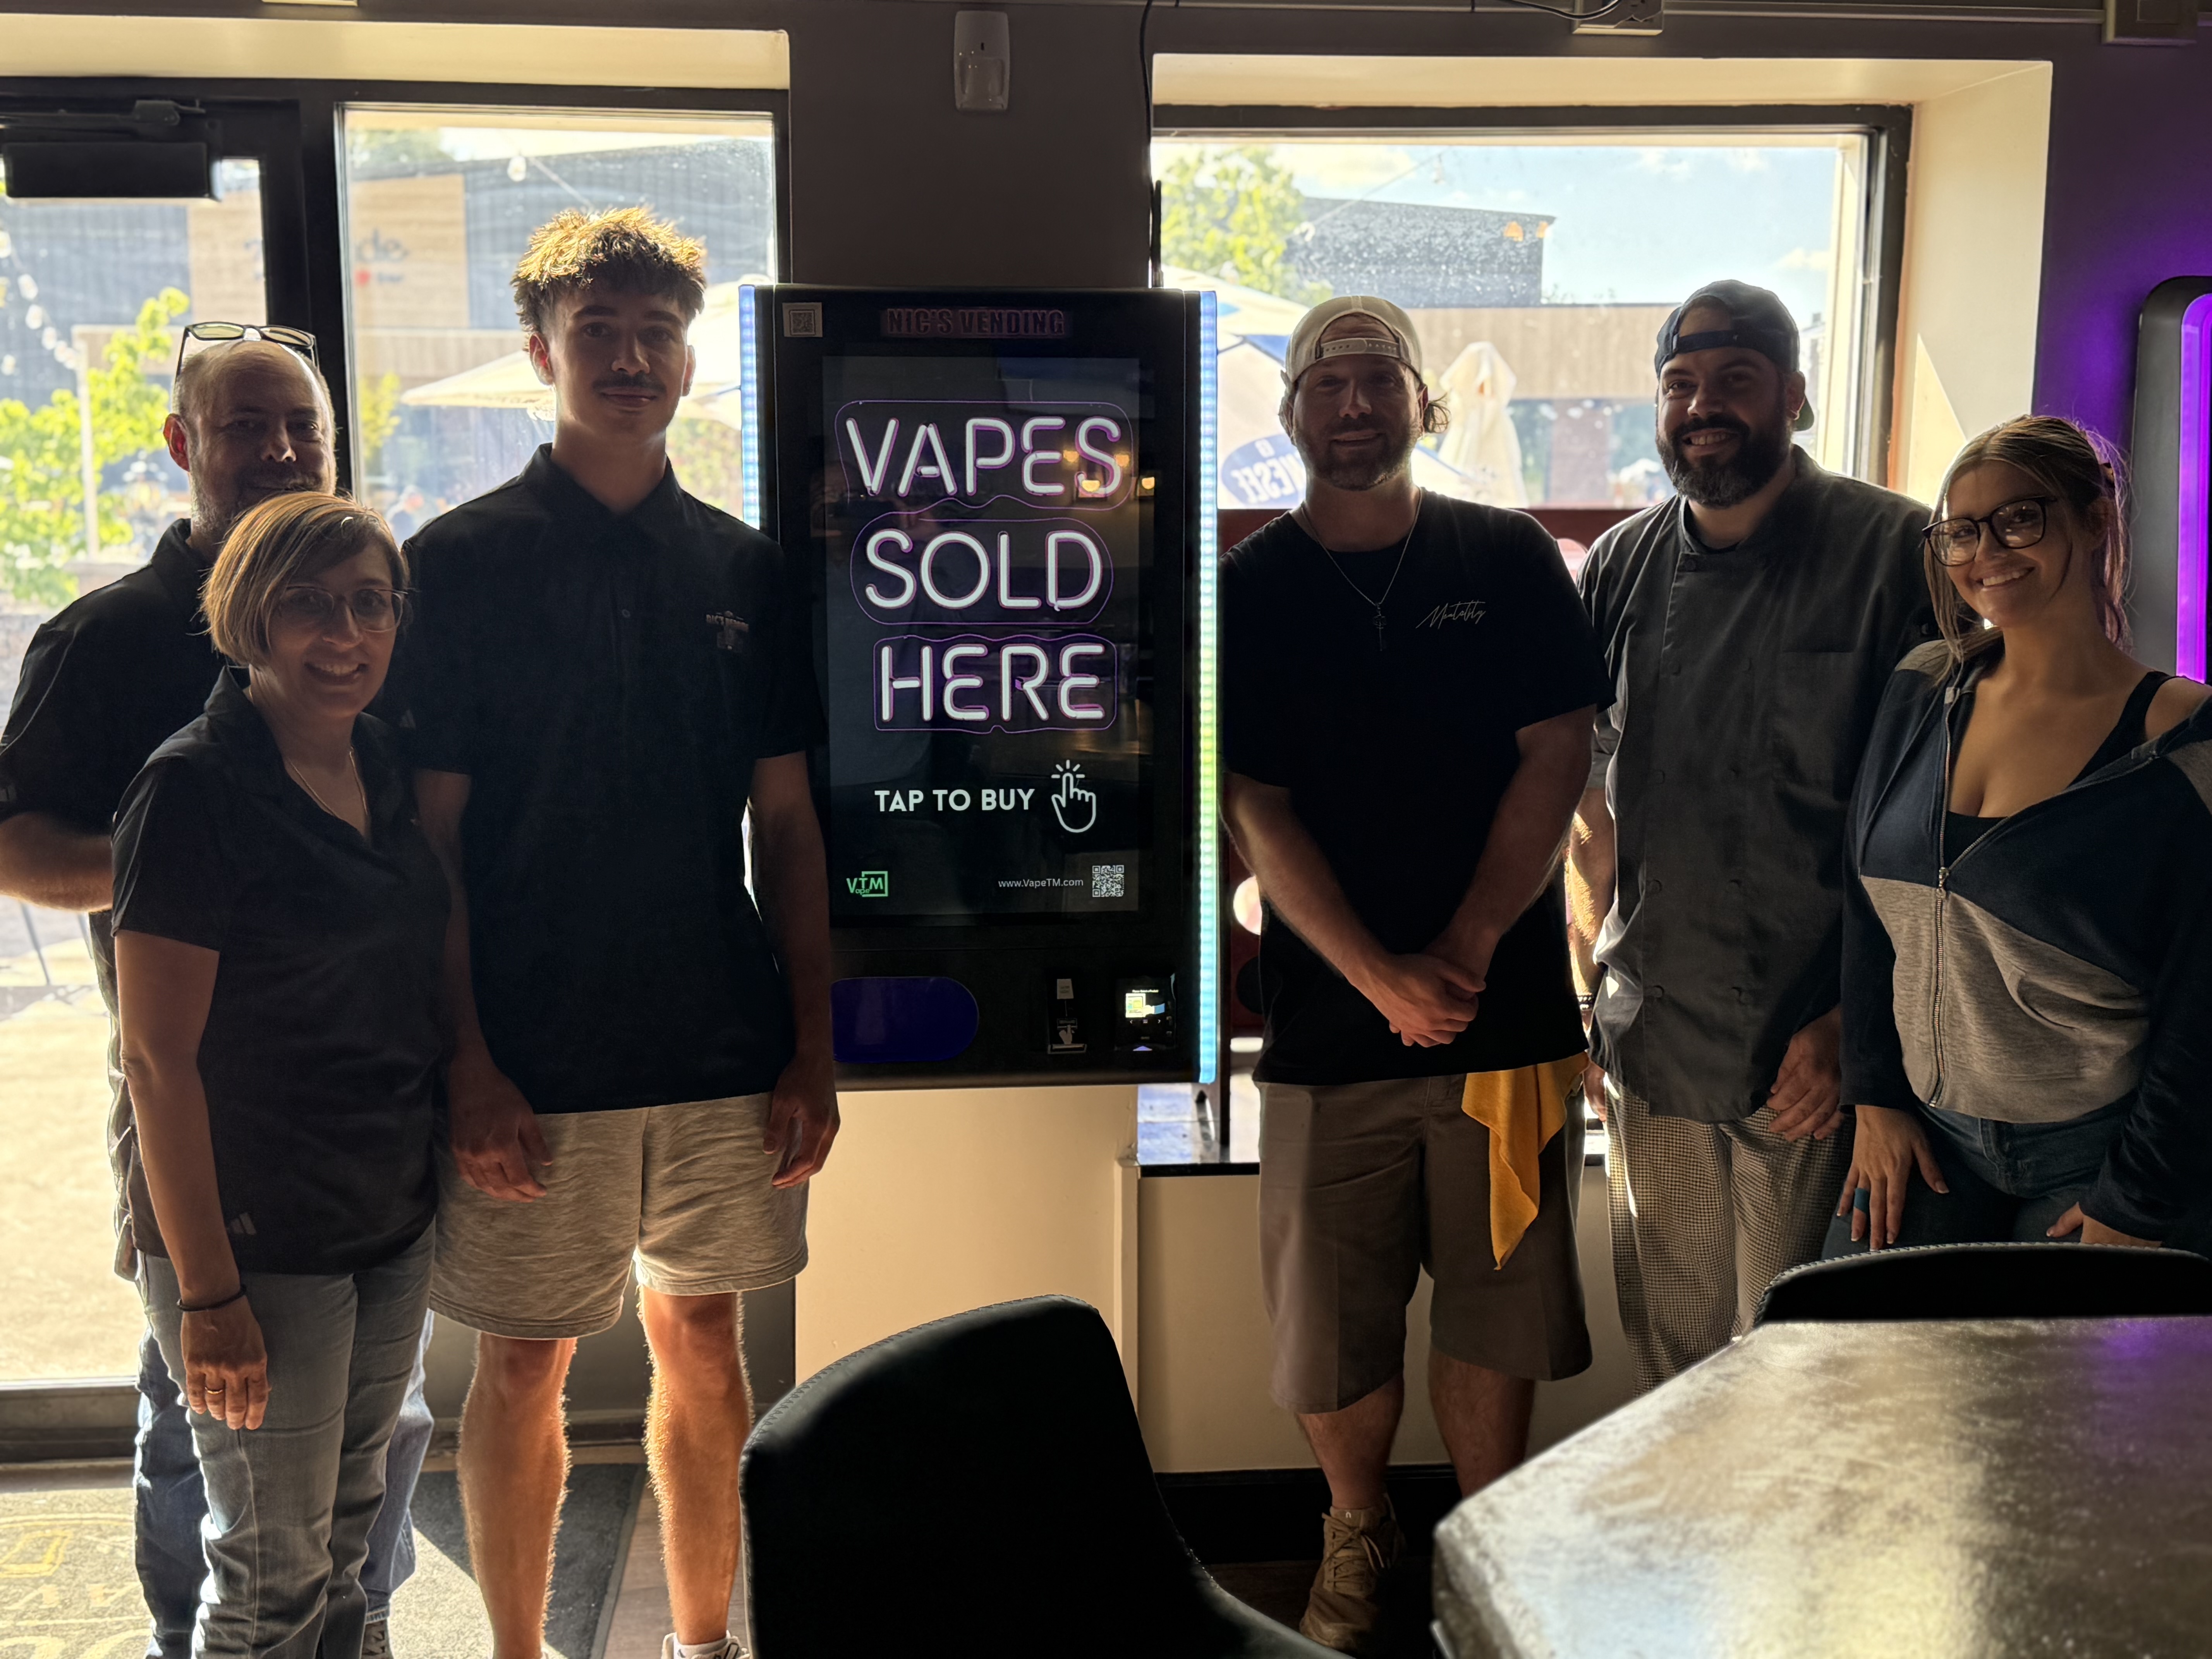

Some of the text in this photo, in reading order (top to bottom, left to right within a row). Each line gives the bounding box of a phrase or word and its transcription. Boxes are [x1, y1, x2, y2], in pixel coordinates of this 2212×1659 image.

[887, 308, 1064, 336] NIC'S VENDING
[845, 416, 1122, 497] VAPES
[866, 528, 1103, 610] SOLD
[881, 643, 1106, 722] HERE
[874, 788, 1036, 812] TAP TO BUY
[998, 878, 1084, 889] www.VapeTM.com
